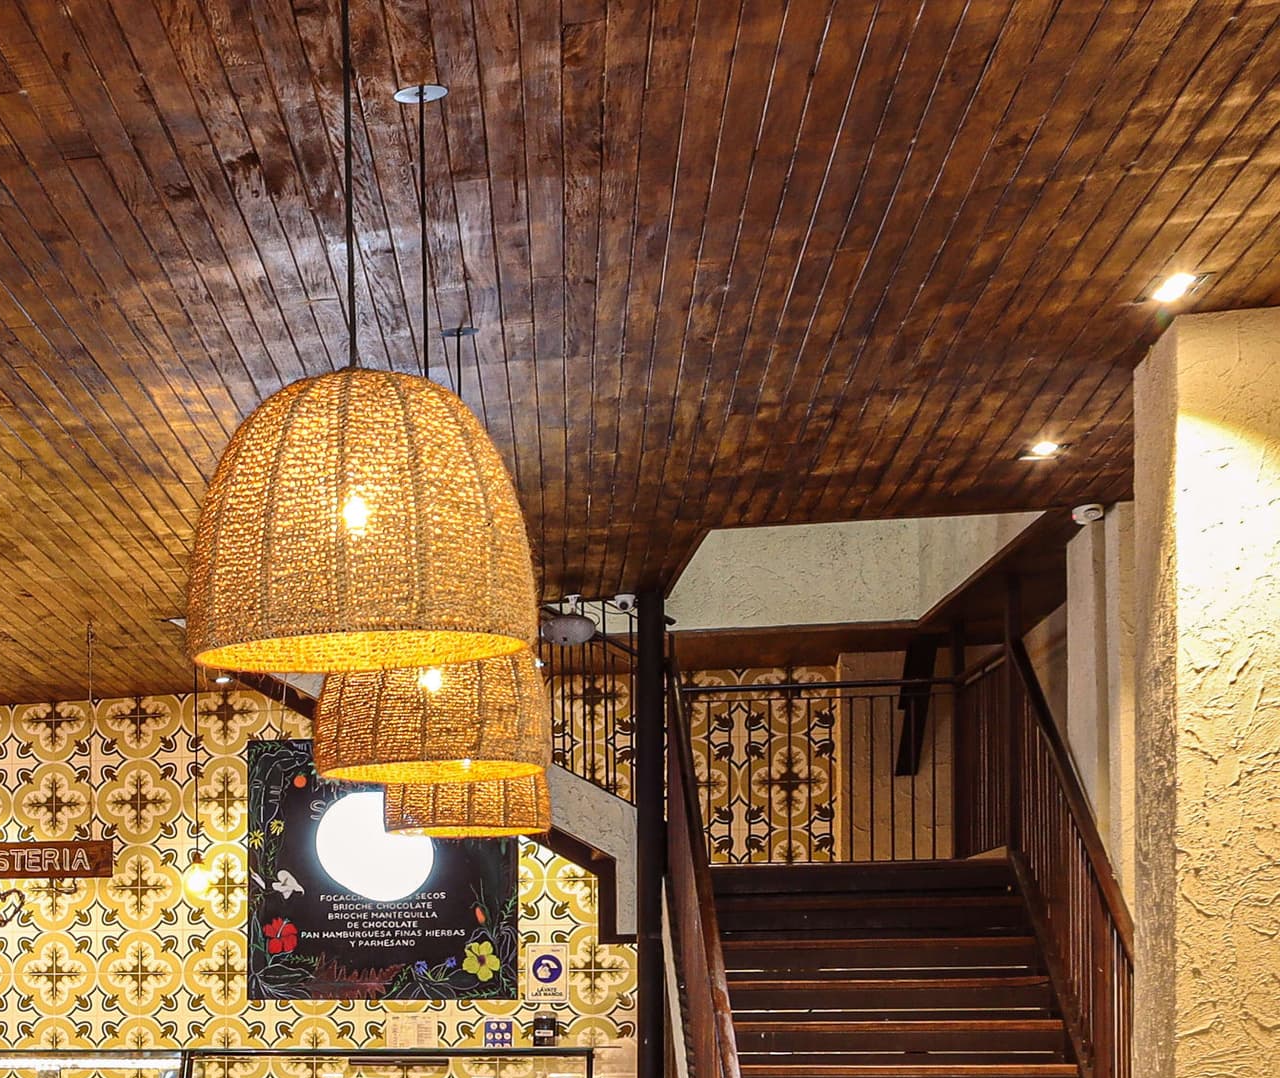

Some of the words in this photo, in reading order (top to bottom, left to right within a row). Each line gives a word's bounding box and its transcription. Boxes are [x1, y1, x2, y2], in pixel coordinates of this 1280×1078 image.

[332, 902, 373, 911] BRIOCHE
[375, 901, 433, 910] CHOCOLATE
[327, 911, 369, 920] BRIOCHE
[371, 910, 438, 920] MANTEQUILLA
[346, 920, 359, 929] DE
[361, 920, 419, 929] CHOCOLATE
[300, 930, 320, 939] PAN
[322, 929, 392, 939] HAMBURGUESA
[394, 929, 423, 938] FINAS
[425, 928, 466, 938] HIERBAS
[349, 940, 356, 948] Y
